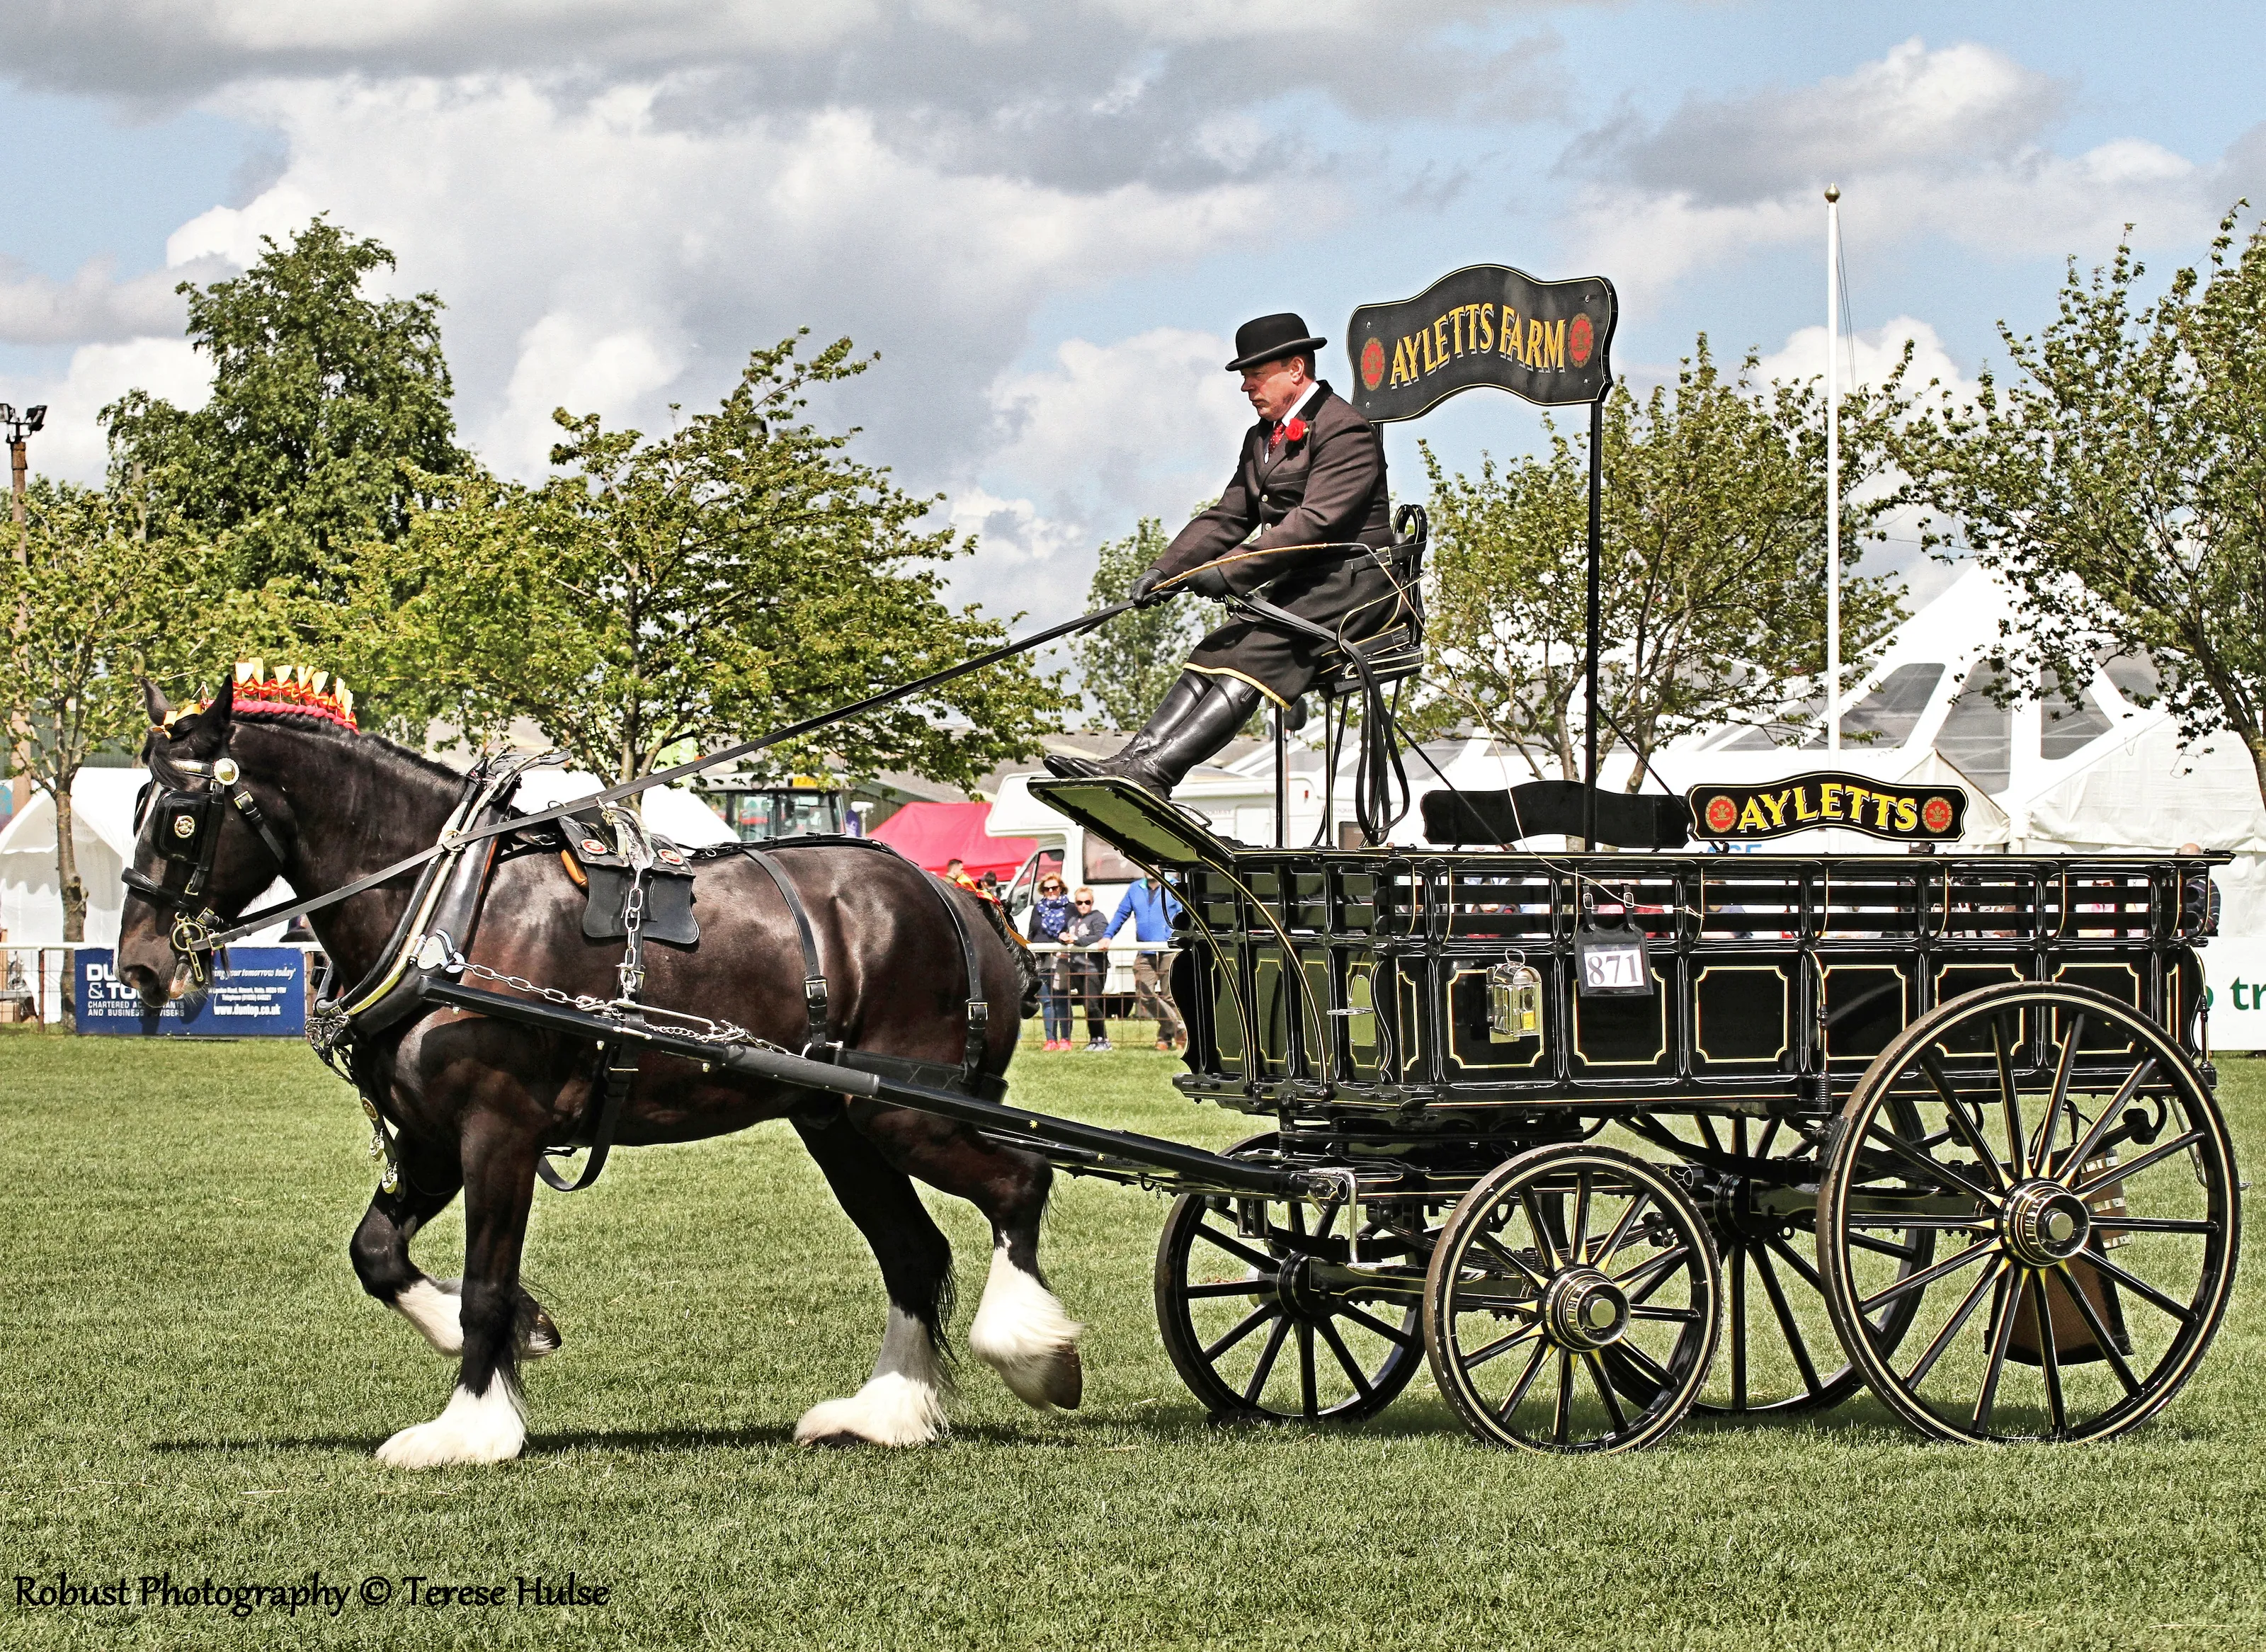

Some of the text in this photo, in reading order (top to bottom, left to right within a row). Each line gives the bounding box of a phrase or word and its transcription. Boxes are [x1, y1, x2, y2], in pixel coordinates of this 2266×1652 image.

[1389, 302, 1566, 389] AYLETTS FARM
[1736, 782, 1917, 833] AYLETTS
[241, 969, 275, 977] tomorrow
[1587, 953, 1639, 986] 871
[88, 981, 105, 1000] &
[213, 1003, 281, 1018] www.duntop.co.uk
